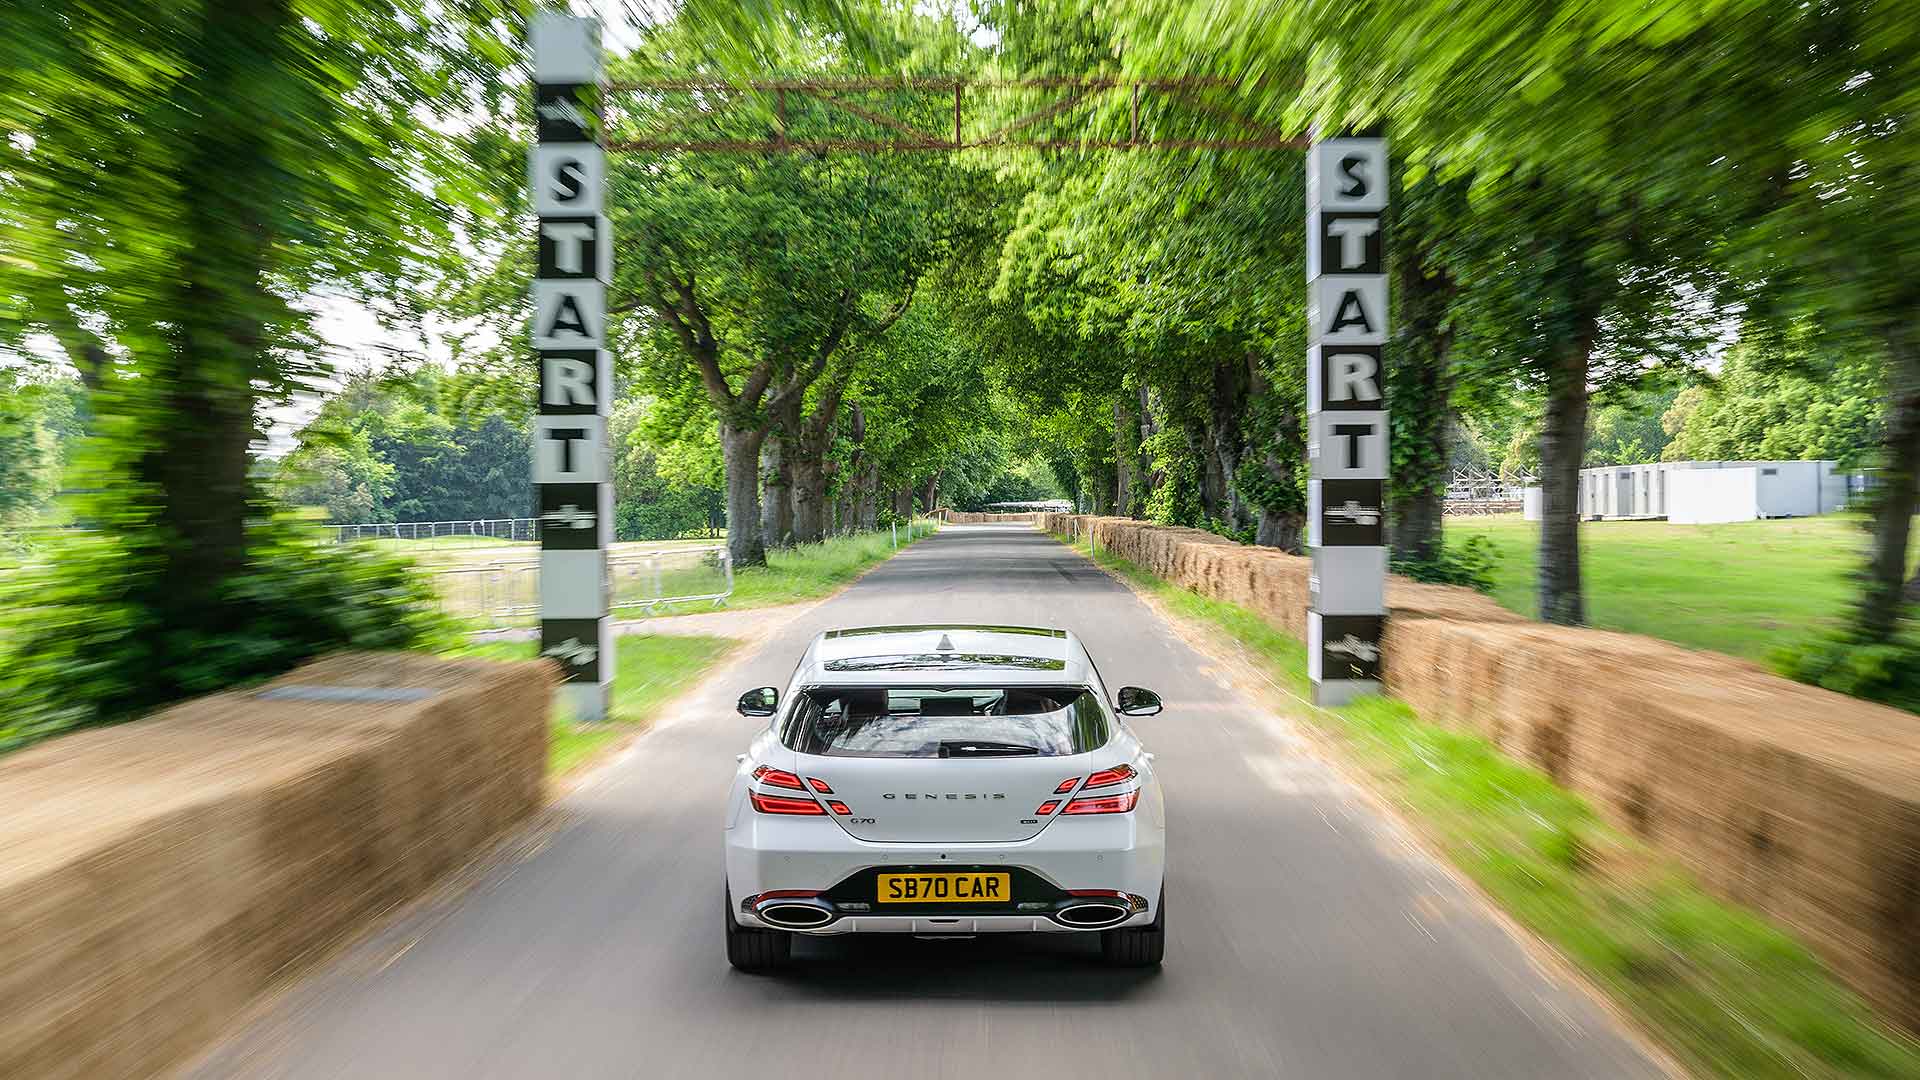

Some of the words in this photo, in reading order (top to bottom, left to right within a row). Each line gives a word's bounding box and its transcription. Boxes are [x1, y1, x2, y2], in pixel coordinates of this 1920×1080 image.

[543, 161, 597, 475] START
[1326, 157, 1382, 470] START
[888, 877, 949, 899] SB70
[955, 876, 1000, 898] CAR
